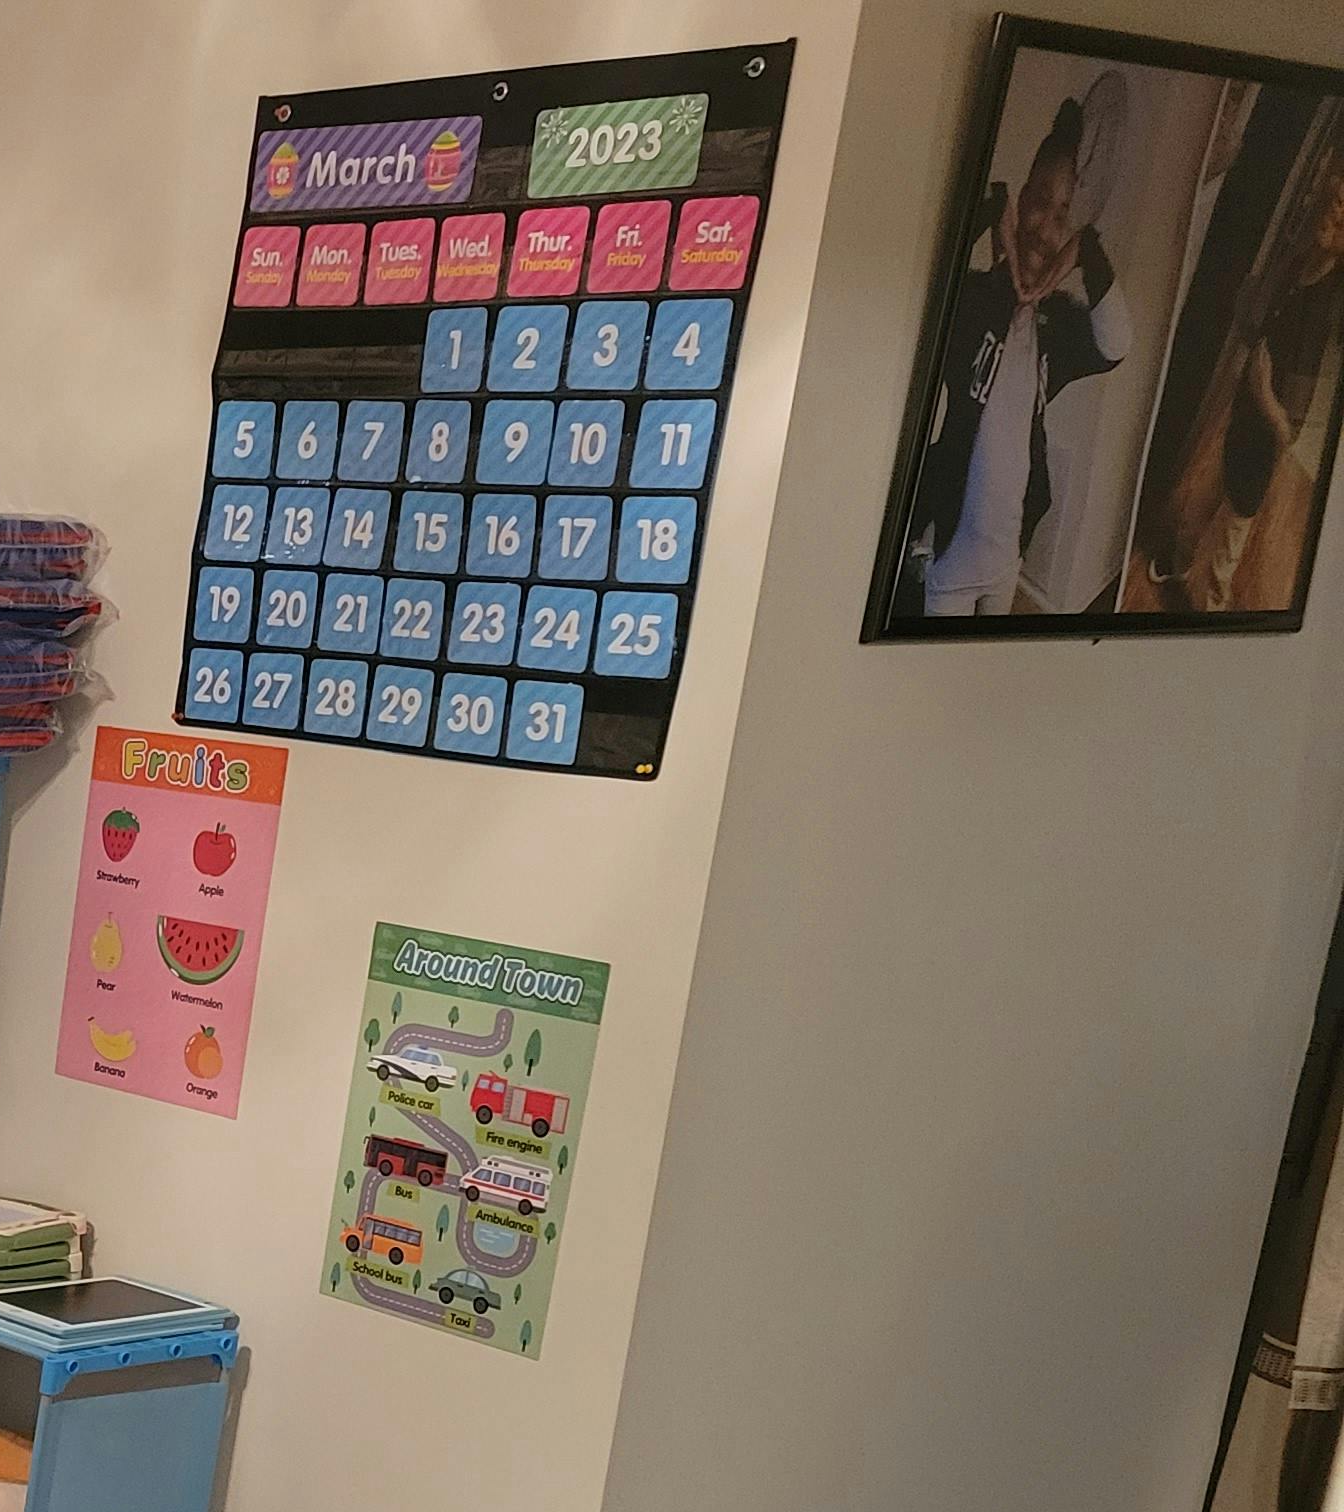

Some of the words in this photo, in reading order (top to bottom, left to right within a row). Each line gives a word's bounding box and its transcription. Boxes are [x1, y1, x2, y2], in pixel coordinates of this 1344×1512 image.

[306, 144, 416, 189] March
[566, 121, 664, 168] 2023
[251, 248, 284, 267] Sun.
[312, 246, 351, 265] Mon.
[380, 242, 422, 262] Tues.
[448, 237, 492, 259] Wed.
[528, 231, 572, 253] Thur.
[616, 225, 642, 248] Fri.
[696, 221, 734, 244] Sat.
[245, 268, 282, 286] Sunday
[307, 266, 351, 285] Monday
[375, 264, 422, 282] Tuesday
[437, 260, 498, 279] Wednesday
[519, 255, 574, 272] Thursday
[607, 250, 646, 268] Friday
[682, 246, 741, 265] Saturday
[449, 331, 461, 368] 1
[516, 328, 540, 369] 2
[594, 325, 618, 367] 3
[672, 323, 700, 365] 4
[234, 422, 255, 458] 5
[298, 422, 318, 459] 6
[364, 423, 384, 459] 7
[429, 423, 450, 461] 8
[505, 423, 529, 462] 9
[570, 423, 606, 465] 10
[661, 424, 692, 466] 11
[223, 505, 250, 541] 12
[284, 507, 313, 544] 13
[343, 510, 373, 548] 14
[414, 513, 448, 552] 15
[486, 516, 520, 555] 16
[558, 518, 596, 557] 17
[639, 519, 677, 559] 18
[210, 586, 239, 622] 19
[267, 590, 306, 626] 20
[336, 594, 368, 632] 21
[391, 600, 431, 638] 22
[462, 604, 505, 643] 23
[531, 610, 579, 650] 24
[610, 614, 660, 655] 25
[195, 668, 231, 704] 26
[254, 672, 291, 708] 27
[315, 678, 355, 715] 28
[378, 685, 422, 725] 29
[448, 695, 493, 735] 30
[526, 703, 566, 742] 31
[122, 738, 249, 793] Fruits
[97, 870, 140, 888] Strawberry
[199, 883, 224, 898] Apple
[394, 938, 502, 989] Around
[502, 958, 584, 1006] Town
[97, 979, 116, 992] Pear
[171, 990, 223, 1011] Watermelon
[94, 1062, 125, 1078] Banana
[186, 1083, 218, 1100] Orange
[388, 1090, 416, 1106] Police
[418, 1098, 434, 1110] car
[486, 1132, 504, 1146] Fire
[507, 1136, 542, 1154] engine
[395, 1186, 412, 1200] Bus
[476, 1209, 534, 1234] Ambulance
[352, 1261, 384, 1280] School
[384, 1270, 402, 1285] bus
[450, 1314, 471, 1328] Taxi
